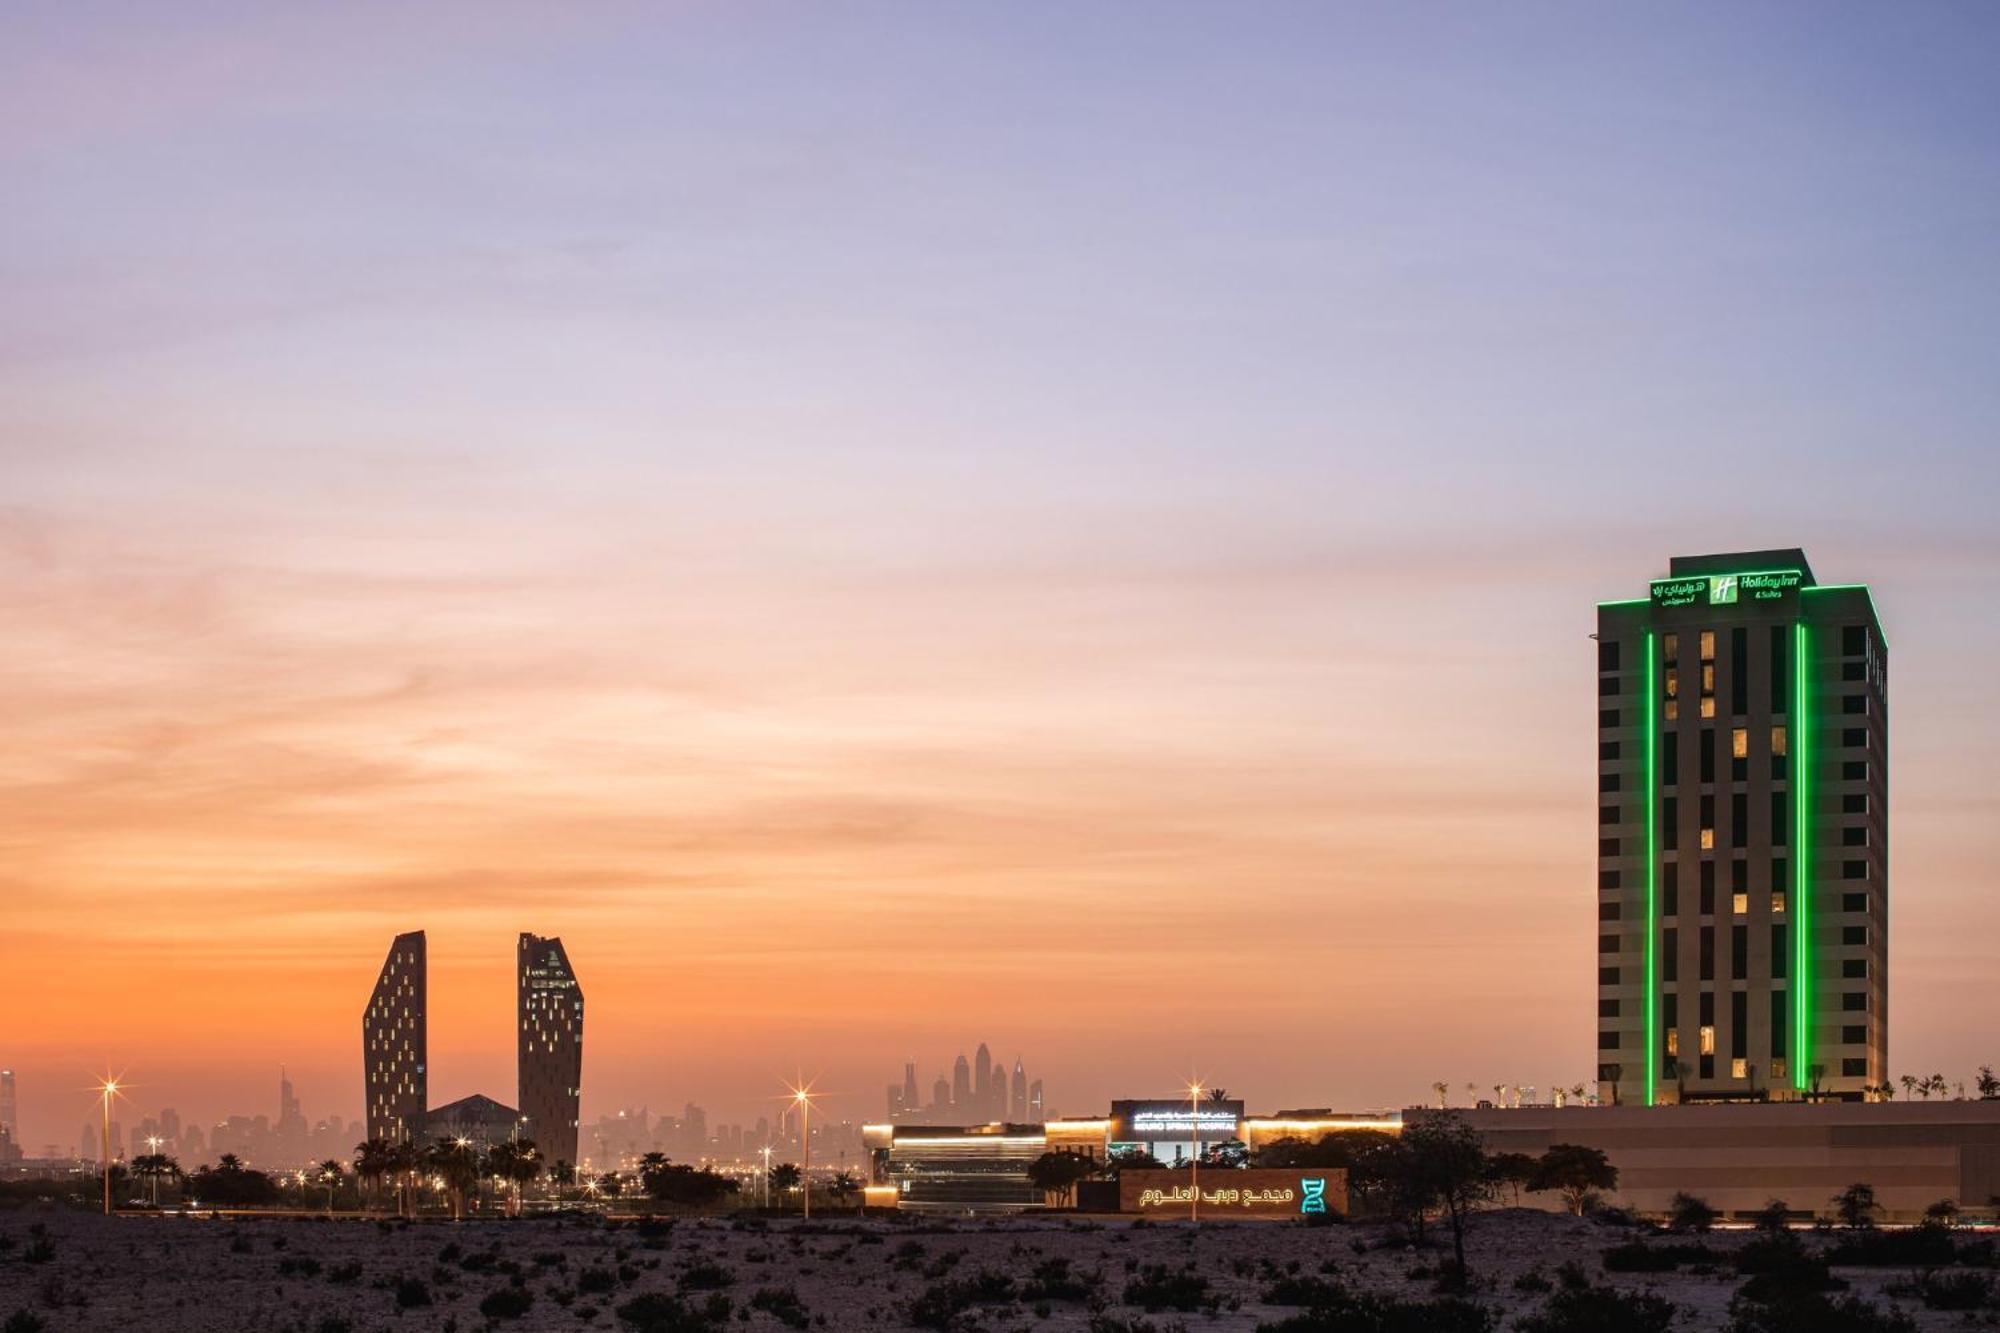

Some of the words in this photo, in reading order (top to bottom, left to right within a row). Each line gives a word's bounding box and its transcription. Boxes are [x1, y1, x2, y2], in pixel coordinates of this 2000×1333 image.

[1741, 575, 1780, 589] Holiday
[1780, 574, 1798, 586] Inn
[1140, 1186, 1199, 1207] العلوم
[1203, 1187, 1239, 1205] دبي
[1242, 1187, 1294, 1207] مجمع
